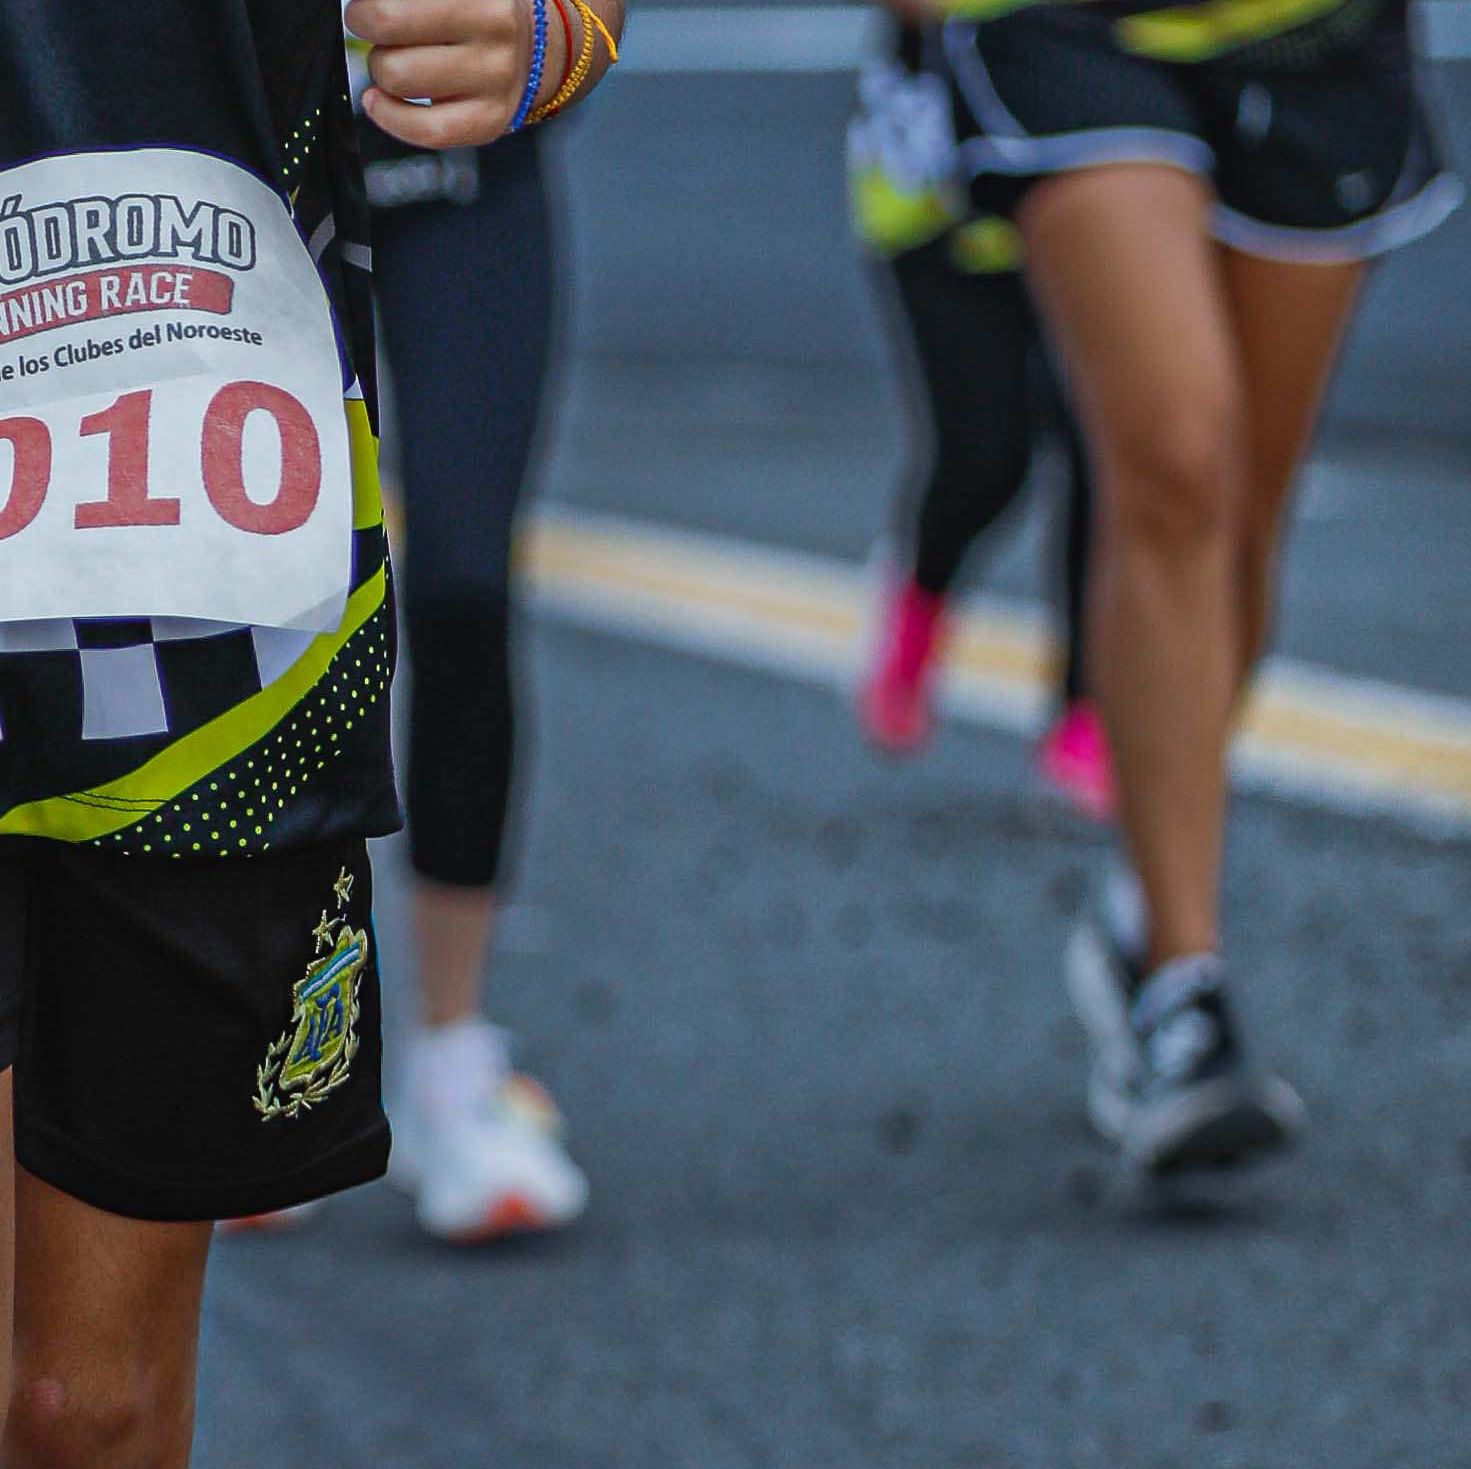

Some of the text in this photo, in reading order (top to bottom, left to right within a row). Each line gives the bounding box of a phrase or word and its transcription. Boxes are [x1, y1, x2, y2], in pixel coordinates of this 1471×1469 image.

[100, 270, 194, 311] RACE
[18, 354, 50, 378] los
[53, 338, 125, 369] Clubes
[128, 323, 162, 351] del
[166, 321, 264, 347] Noroeste
